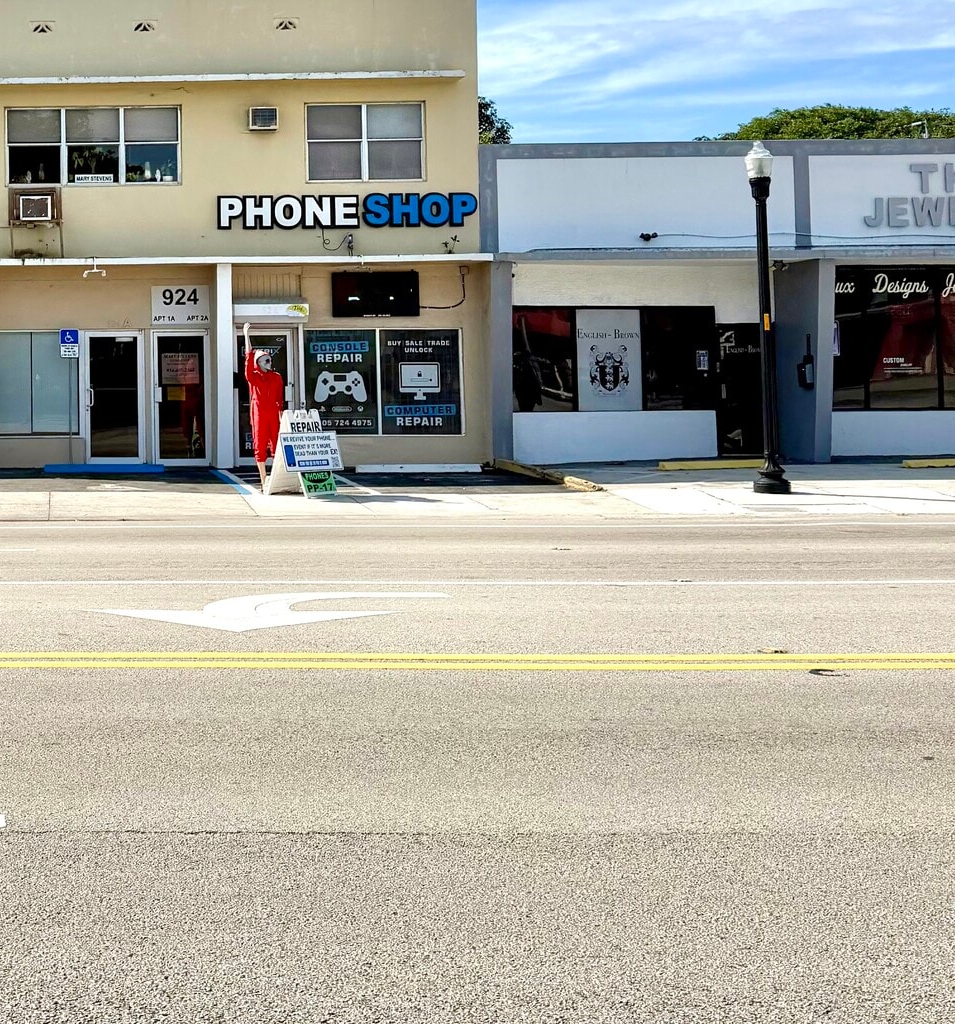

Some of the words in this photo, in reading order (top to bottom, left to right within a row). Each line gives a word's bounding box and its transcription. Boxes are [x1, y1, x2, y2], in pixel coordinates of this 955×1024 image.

[217, 195, 360, 229] PHONE
[362, 193, 478, 228] SHOP
[872, 273, 929, 298] Designs
[162, 288, 199, 306] 924
[312, 343, 367, 352] CONSOLE
[317, 354, 363, 363] REPAIR
[387, 406, 452, 415] COMPUTER
[396, 417, 443, 426] REPAIR
[290, 421, 321, 433] REPAIR
[304, 471, 329, 480] PHONES
[307, 483, 333, 493] PP-17
